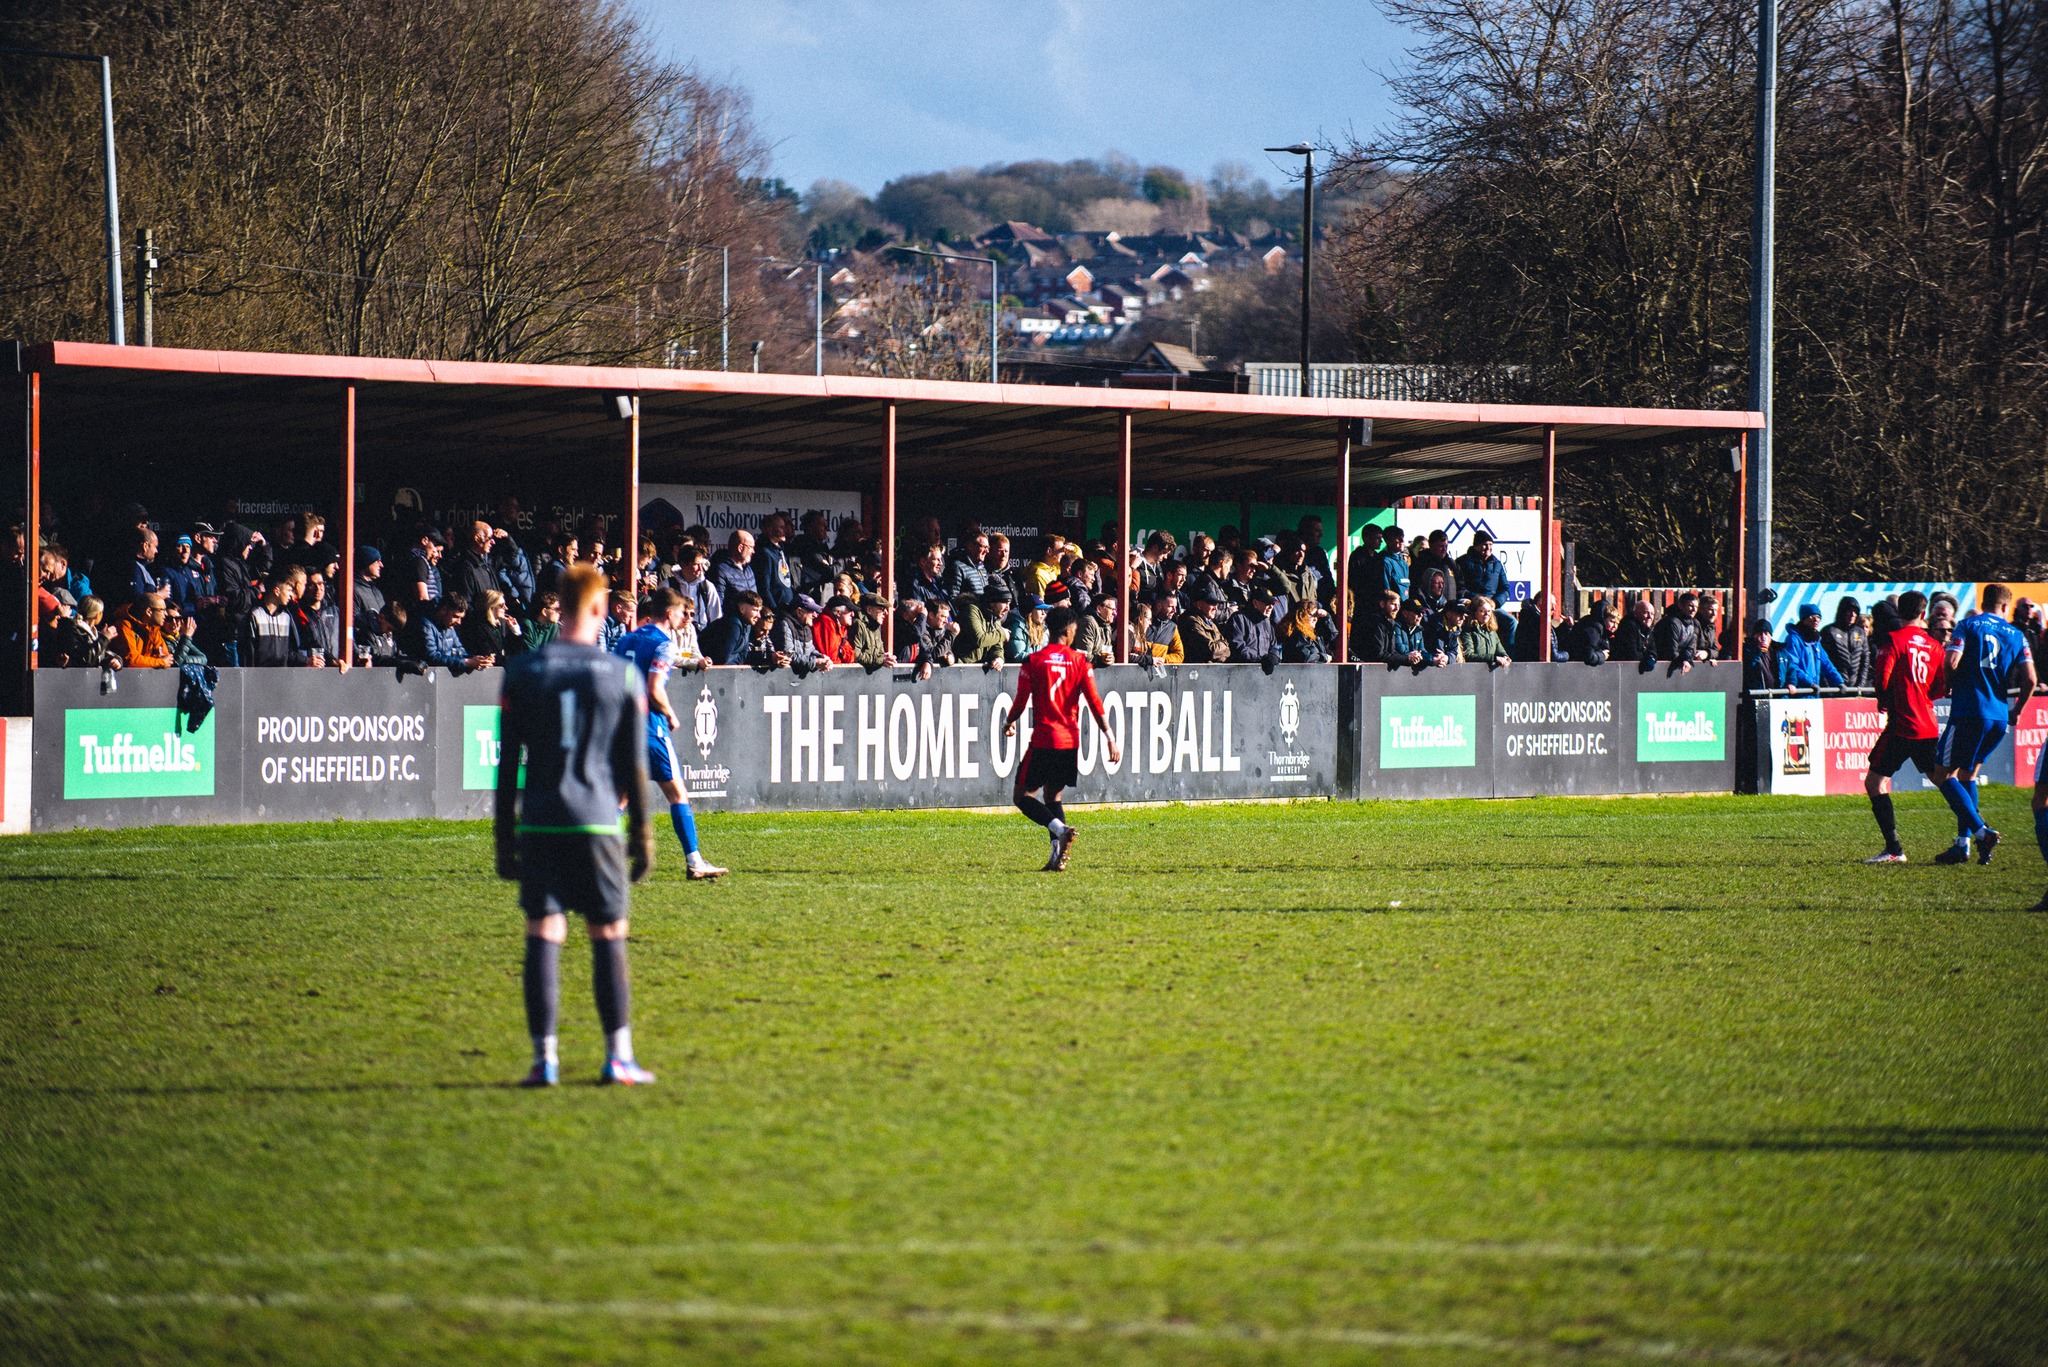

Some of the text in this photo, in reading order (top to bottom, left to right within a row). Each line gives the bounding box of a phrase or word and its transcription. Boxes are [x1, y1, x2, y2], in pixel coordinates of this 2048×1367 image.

[695, 490, 772, 503] BEST WESTERN PLUS
[1980, 634, 2000, 669] 2
[1909, 647, 1931, 684] 16
[1050, 665, 1067, 702] 7
[559, 688, 577, 748] 1
[1504, 700, 1611, 724] PROUD SPONSORS
[258, 715, 425, 743] PROUD SPONSORS
[764, 694, 845, 783] THE
[858, 692, 979, 781] HOME
[1077, 690, 1241, 777] OOTBALL
[1506, 732, 1608, 757] OF SHEFFIELD F.C.
[261, 754, 420, 784] OF SHEFFIELD F.C.
[1268, 750, 1310, 769] Thornbridge
[1277, 765, 1301, 774] BREWERY
[1835, 752, 1844, 770] &
[682, 763, 730, 783] Thornbridge
[692, 780, 719, 790] BREWERY
